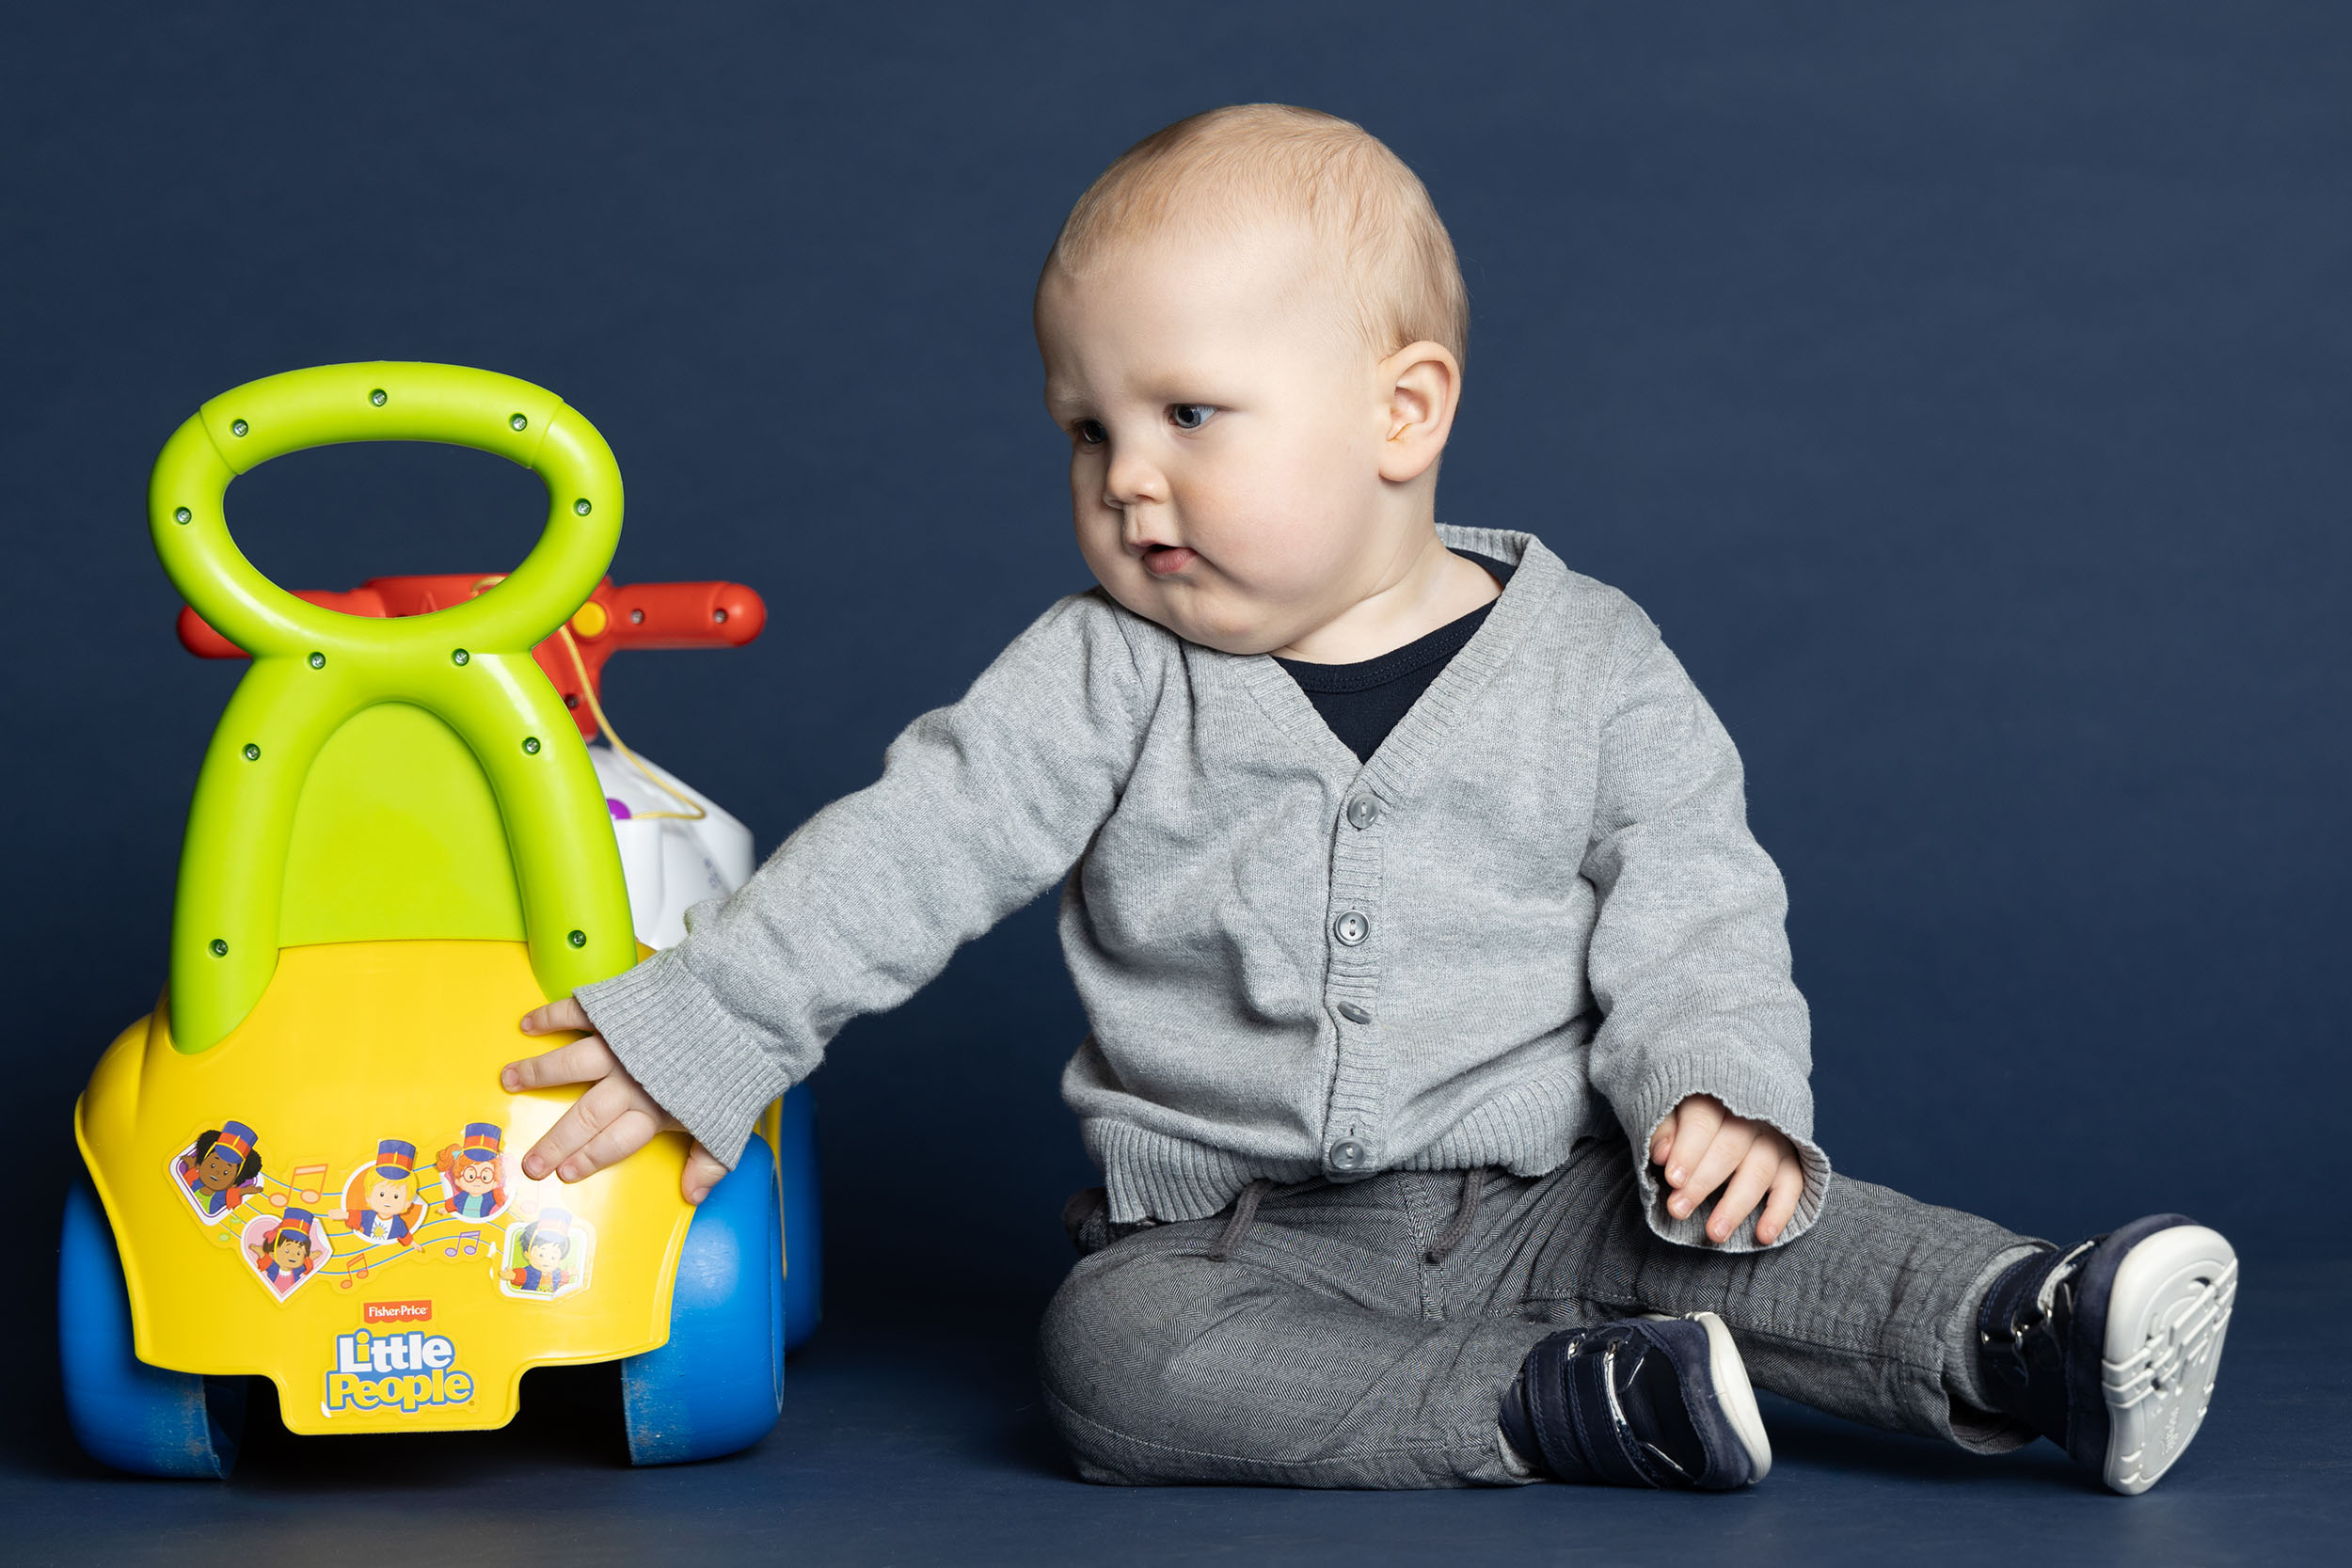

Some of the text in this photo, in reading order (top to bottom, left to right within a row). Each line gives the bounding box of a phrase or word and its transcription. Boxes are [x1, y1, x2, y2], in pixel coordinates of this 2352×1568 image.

[368, 1306, 427, 1318] Fisher-Price
[340, 1331, 453, 1373] Little
[329, 1369, 470, 1410] People
